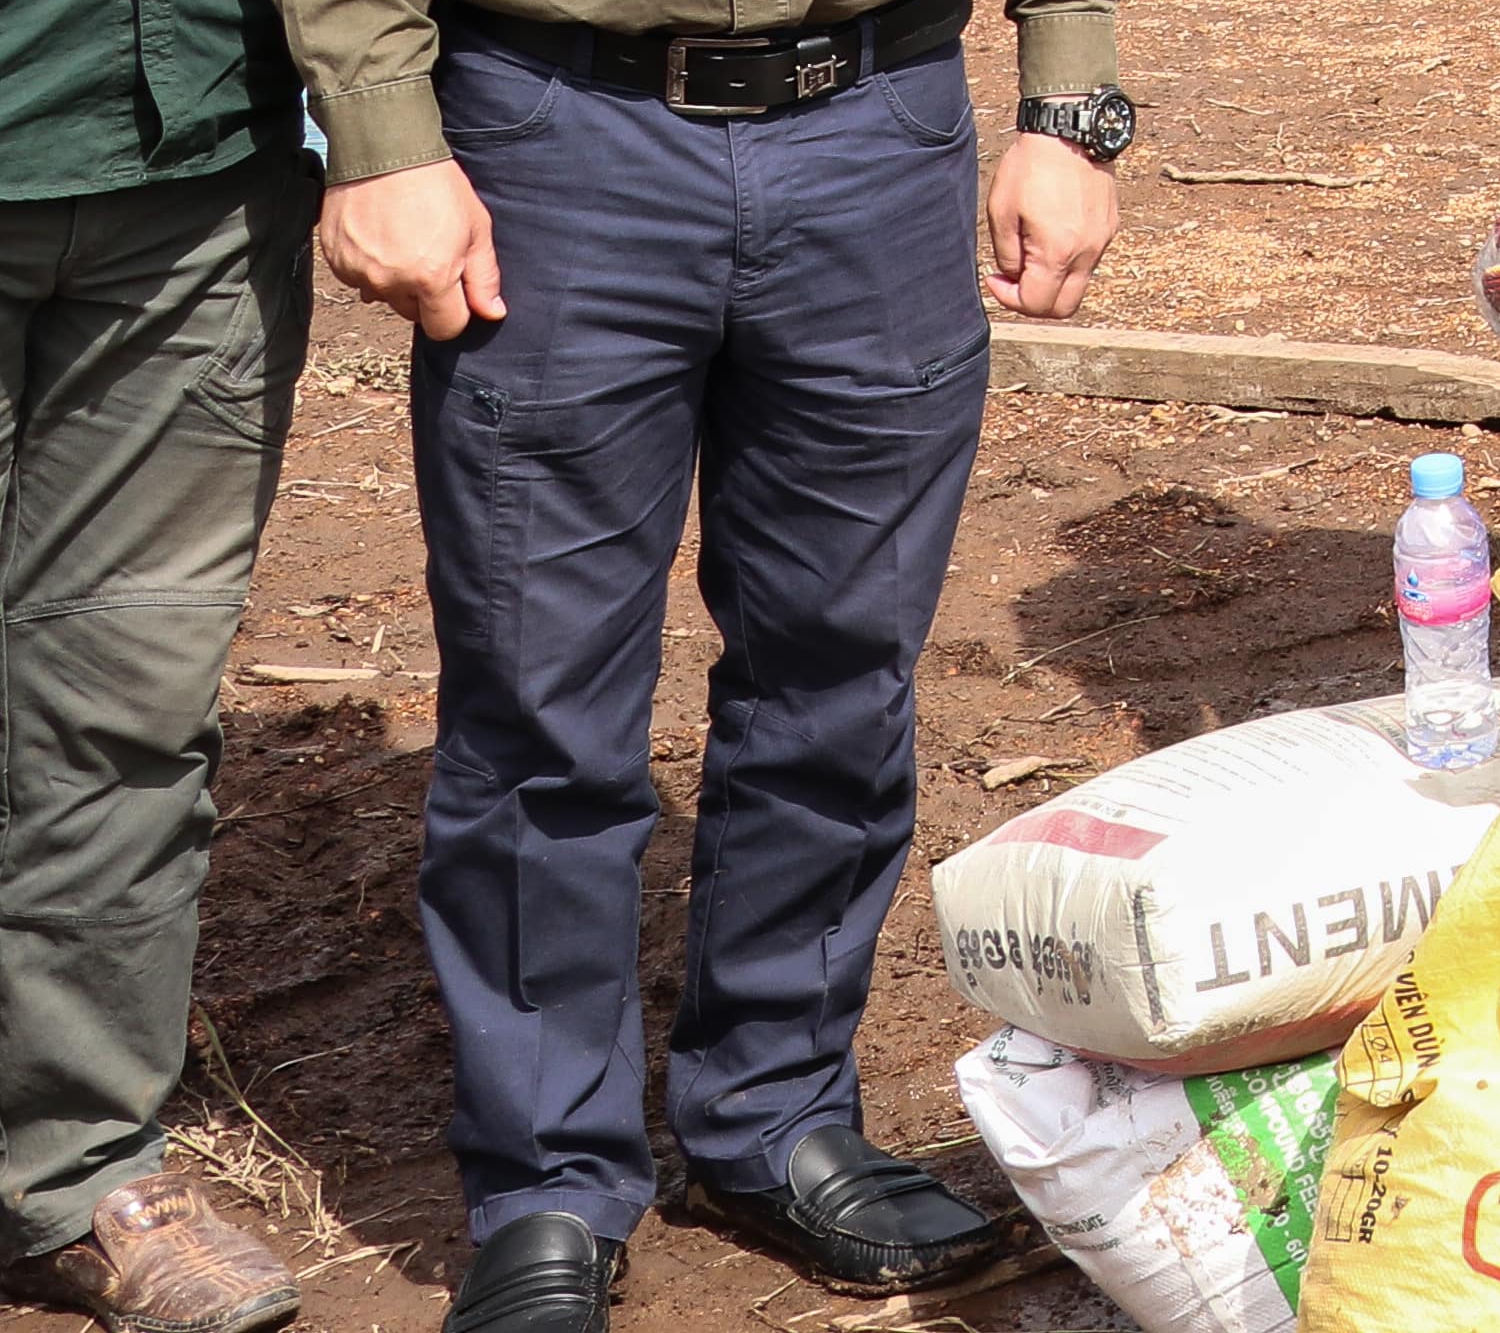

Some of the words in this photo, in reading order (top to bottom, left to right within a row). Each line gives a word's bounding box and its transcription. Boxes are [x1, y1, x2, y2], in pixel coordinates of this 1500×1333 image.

[1195, 864, 1464, 992] MENT
[1395, 971, 1426, 1021] VIÊN
[1407, 1019, 1446, 1069] DÙN
[1242, 1069, 1305, 1172] COMPOUND
[1358, 1147, 1392, 1244] 10-20GR
